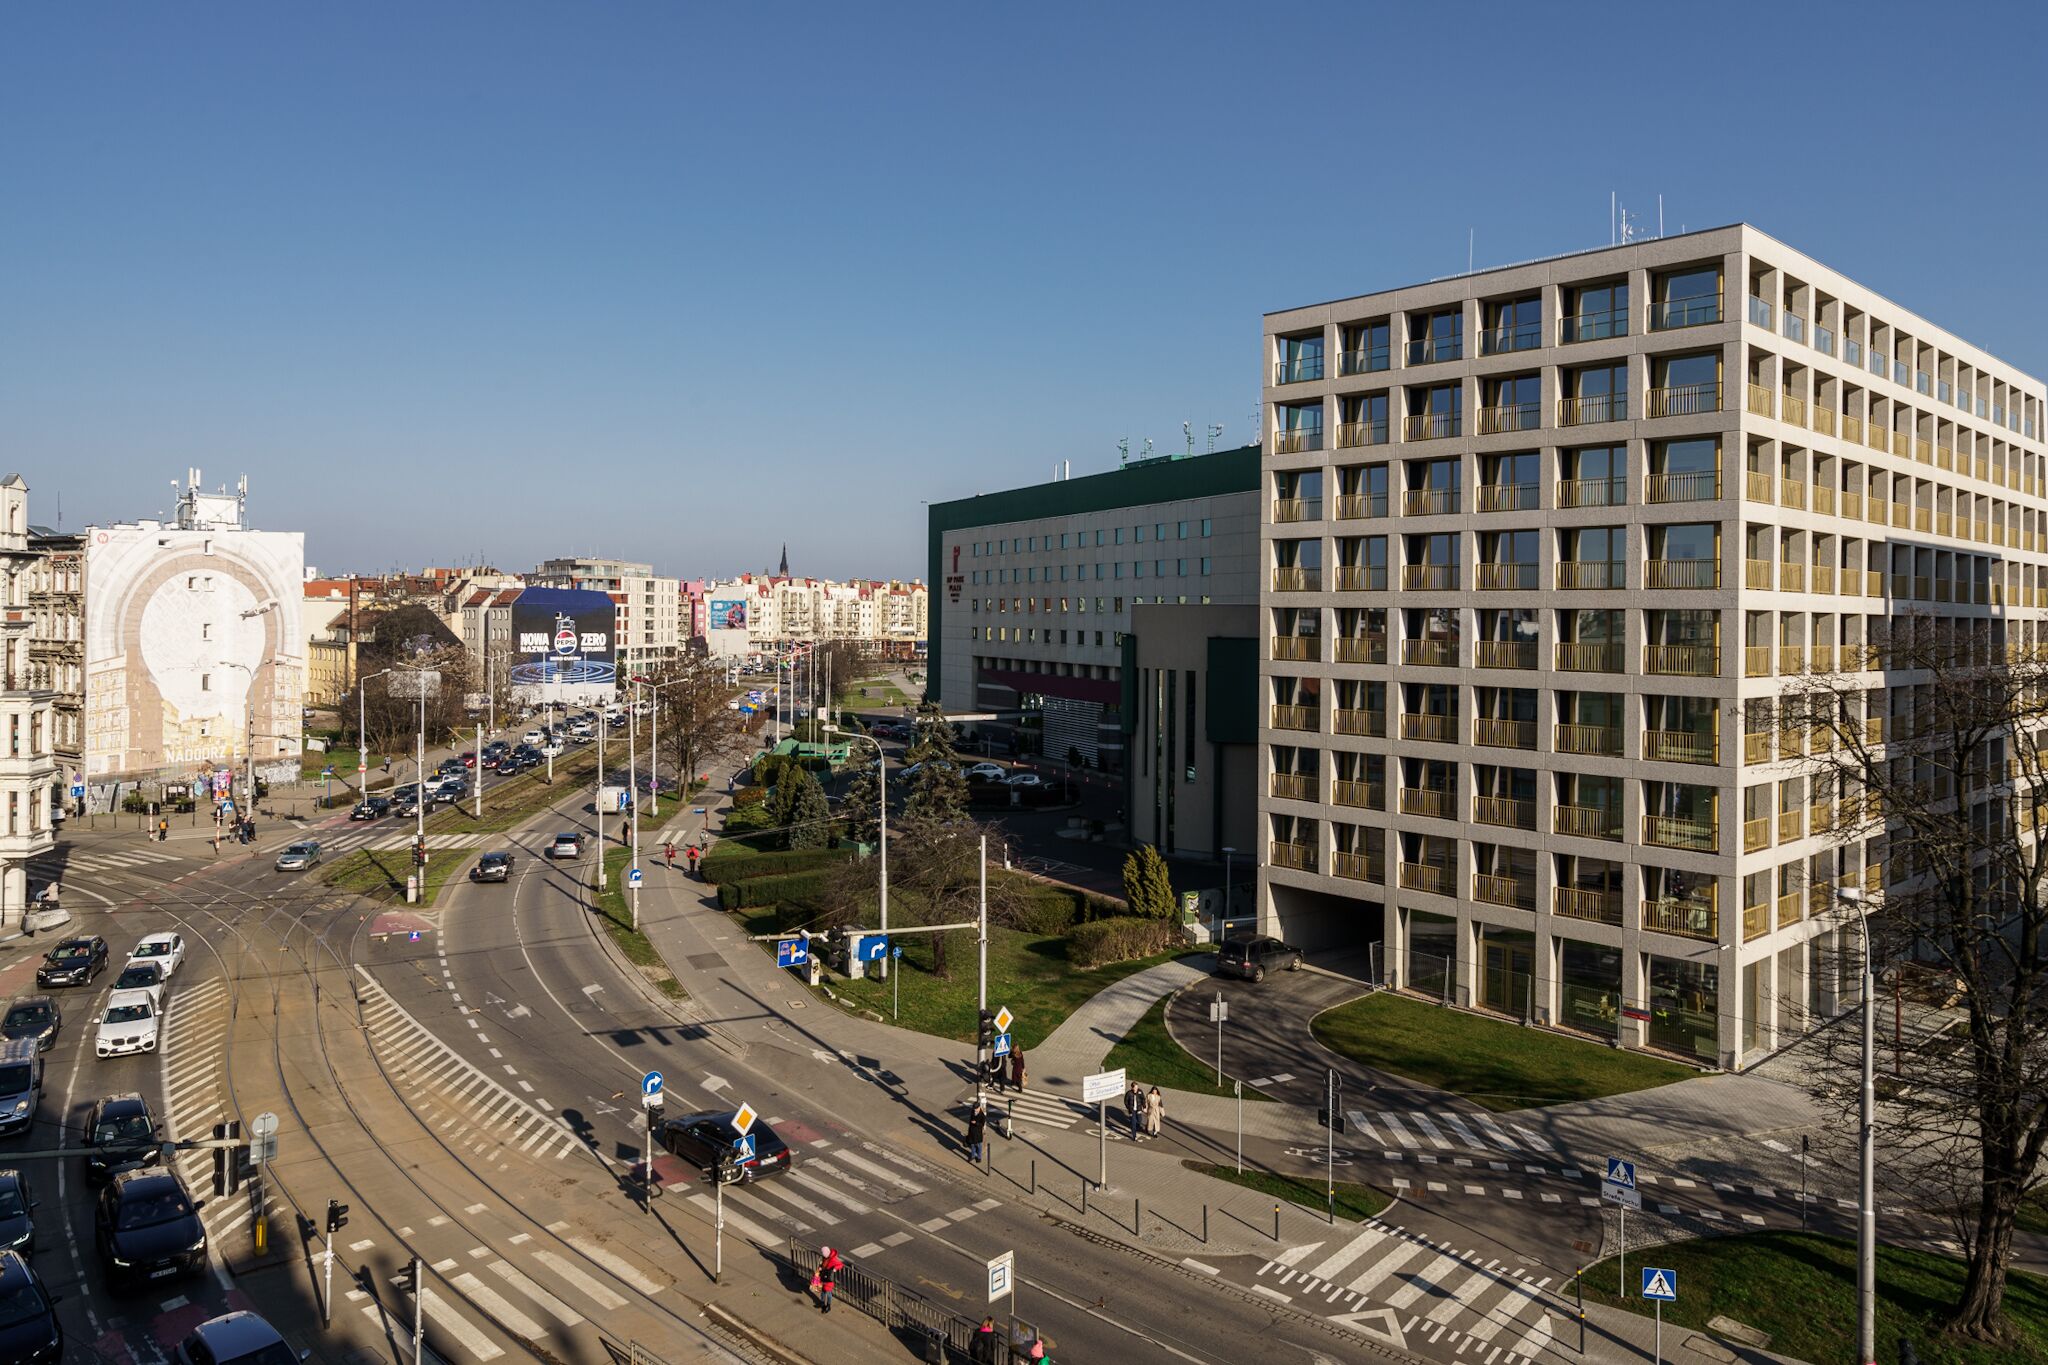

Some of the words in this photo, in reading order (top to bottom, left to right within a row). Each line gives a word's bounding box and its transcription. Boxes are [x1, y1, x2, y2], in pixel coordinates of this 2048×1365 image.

[520, 633, 550, 646] NOWA
[581, 633, 606, 646] ZERO
[1603, 1191, 1620, 1200] Strefa
